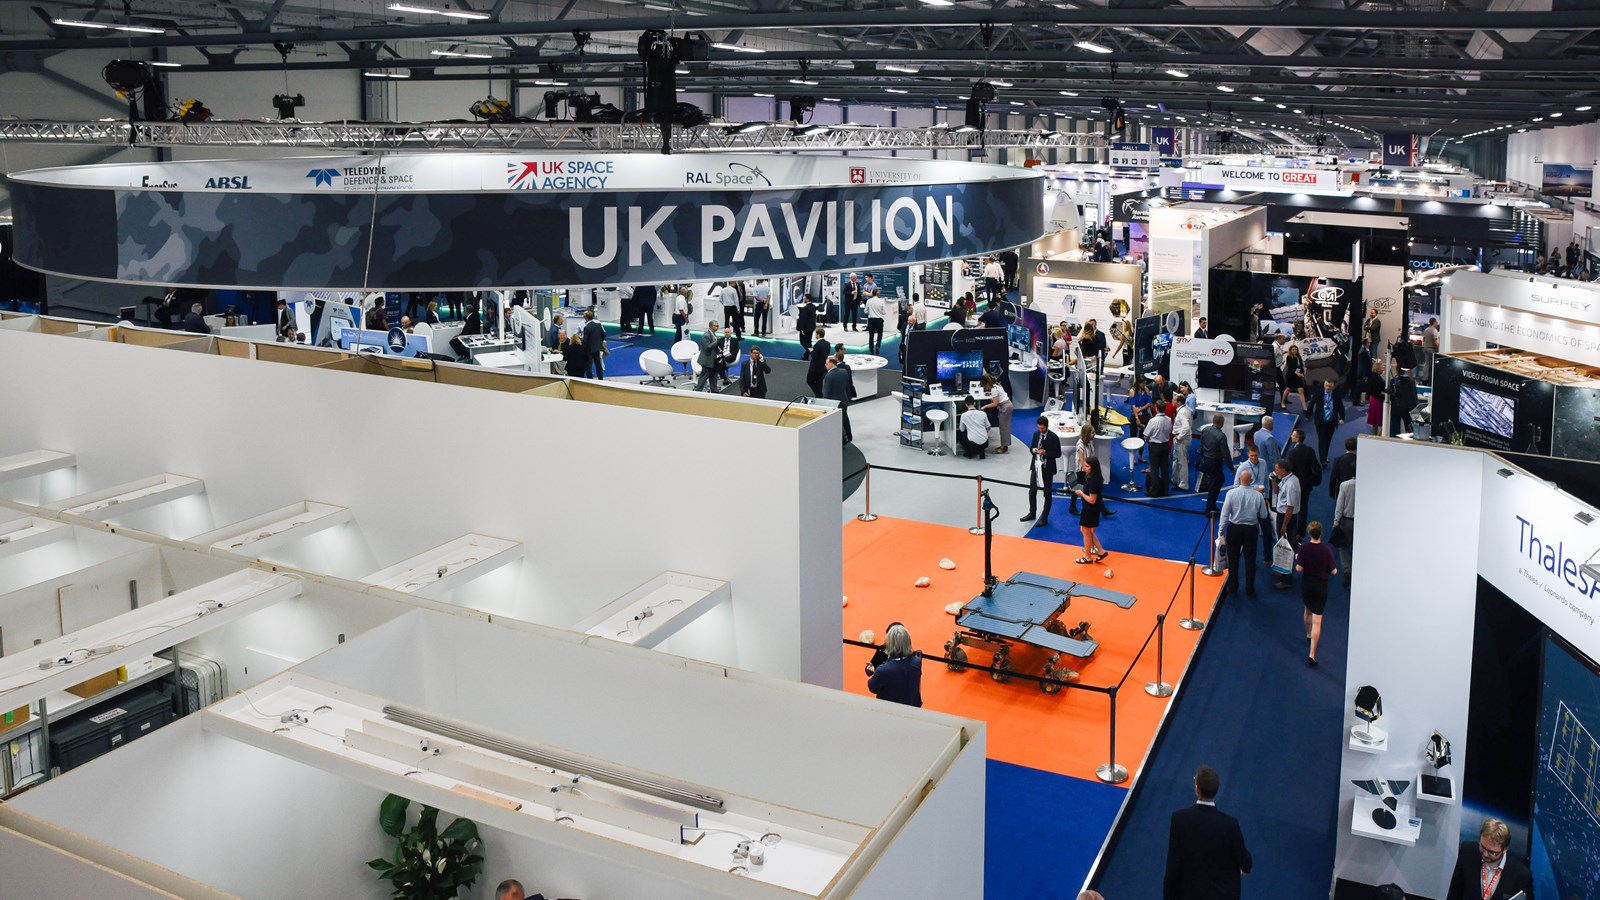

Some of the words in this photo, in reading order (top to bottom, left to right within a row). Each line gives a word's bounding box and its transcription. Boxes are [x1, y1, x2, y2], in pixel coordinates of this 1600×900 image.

[1156, 136, 1170, 146] UK
[1388, 144, 1406, 155] UK
[343, 167, 386, 176] TELEDYNE
[542, 161, 564, 174] UK
[568, 161, 614, 174] SPACE
[344, 176, 378, 186] DEFENCE
[388, 175, 414, 184] SPACE
[686, 172, 712, 184] RAL
[716, 172, 754, 186] Space
[870, 170, 911, 180] UNIVERSITY
[1222, 170, 1265, 180] WELCOME
[1268, 172, 1280, 180] TO
[1283, 173, 1316, 183] GREAT
[542, 176, 608, 190] AGENCY
[569, 205, 679, 270] UK
[701, 195, 954, 264] PAVILION
[1531, 294, 1591, 310] SURREY
[1460, 314, 1498, 330] CHANGING
[1500, 322, 1514, 334] THE
[1517, 327, 1568, 345] ECONOMICS
[1570, 338, 1582, 348] OF
[1212, 348, 1230, 356] gmv
[1462, 370, 1480, 380] VIDEO
[1481, 375, 1499, 387] FROM
[1500, 380, 1520, 392] SPACE
[1524, 569, 1538, 586] Thales
[1544, 585, 1568, 606] Leonardo
[1569, 603, 1594, 626] company
